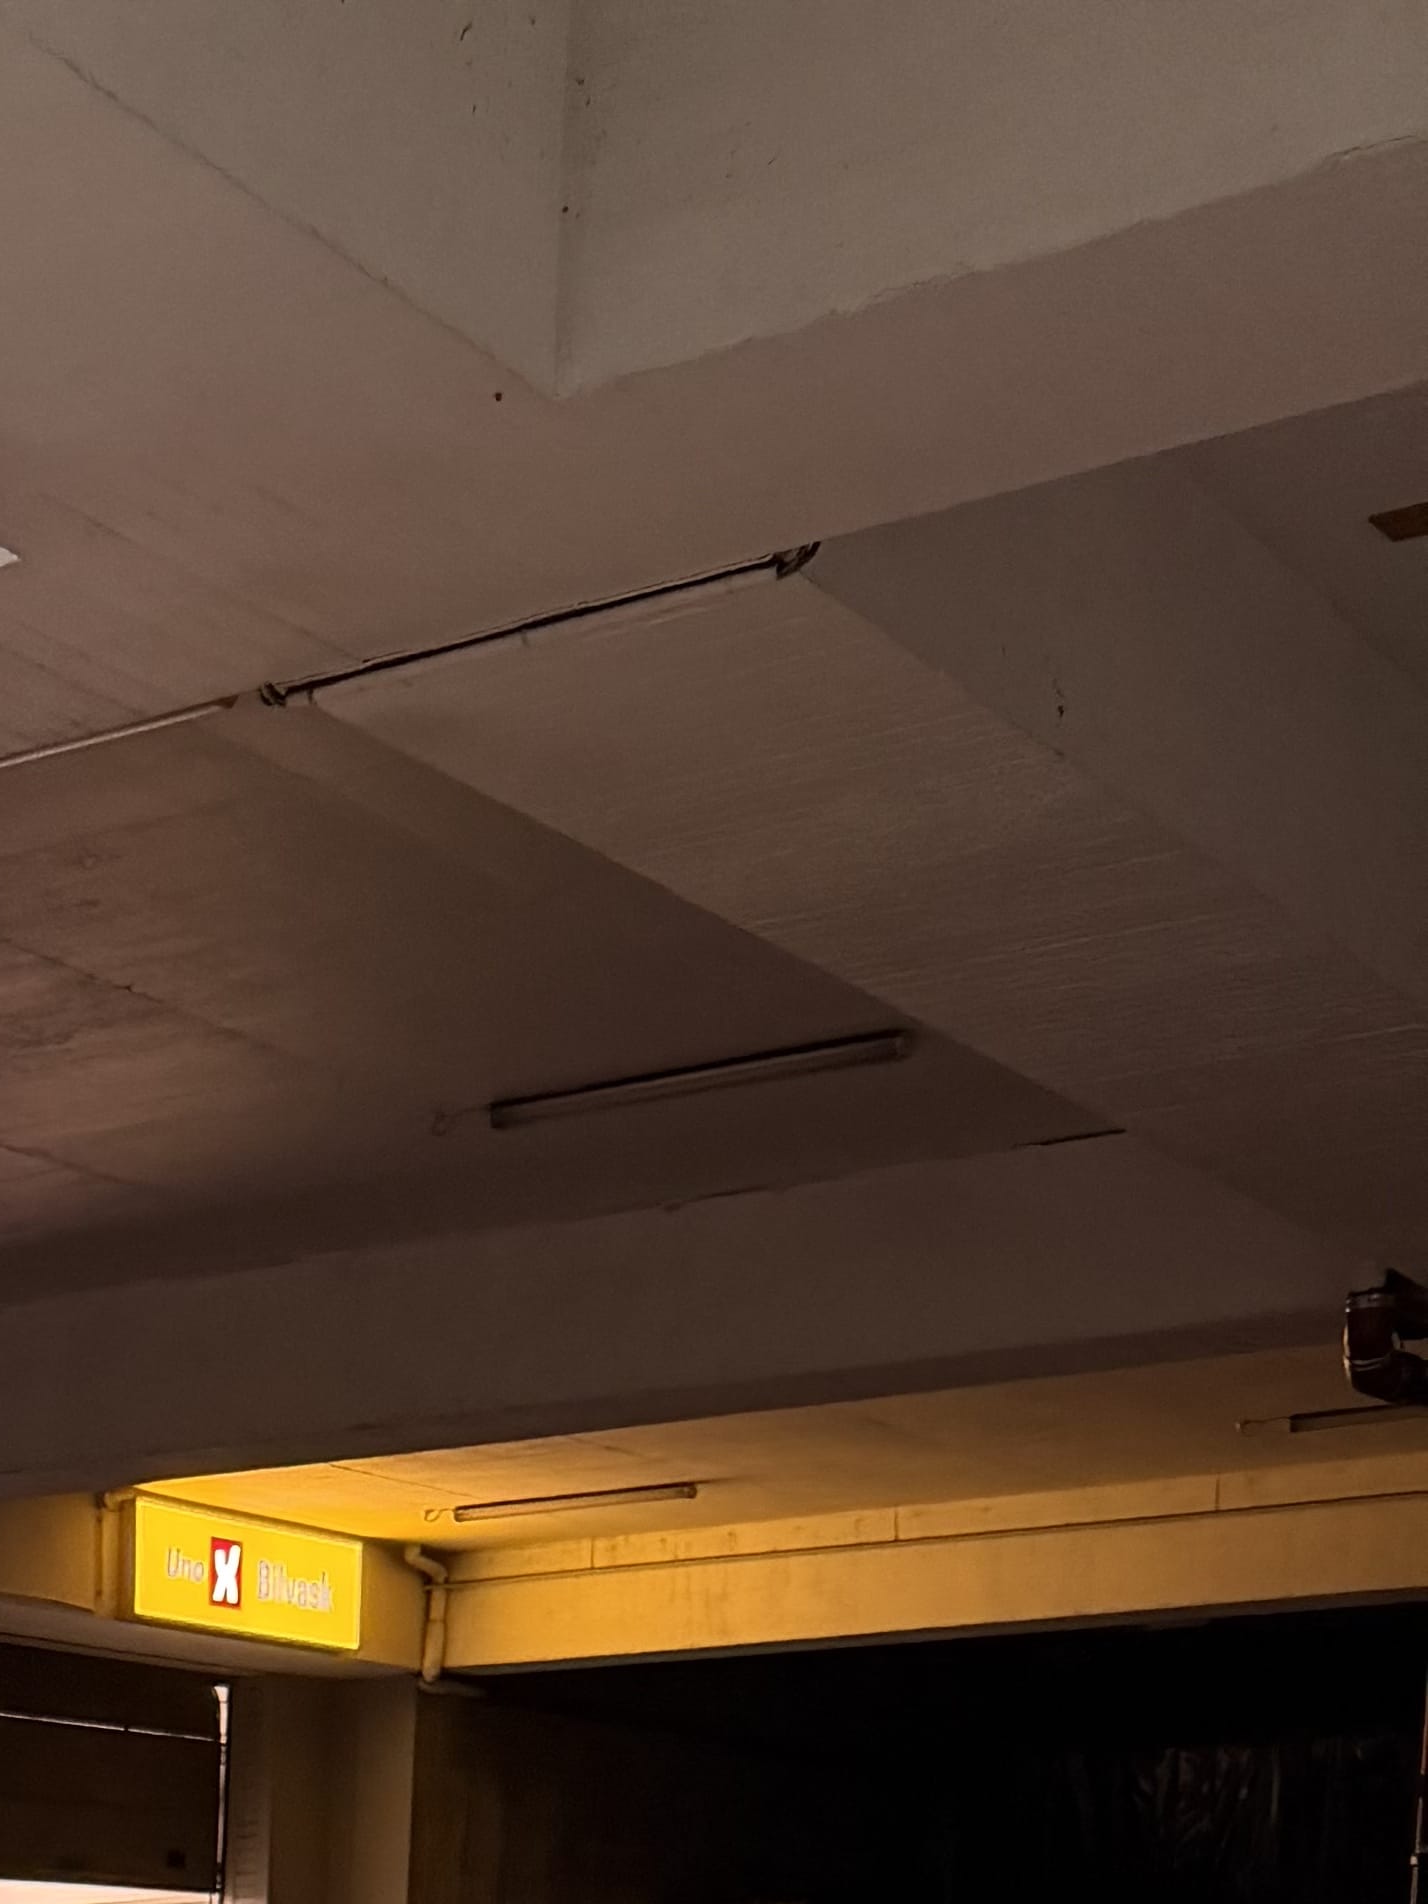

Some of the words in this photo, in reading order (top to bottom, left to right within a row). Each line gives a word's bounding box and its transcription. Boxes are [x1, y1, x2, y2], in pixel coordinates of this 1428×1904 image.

[167, 1548, 204, 1583] Uno
[212, 1545, 241, 1604] X
[258, 1560, 333, 1612] Bilvask
